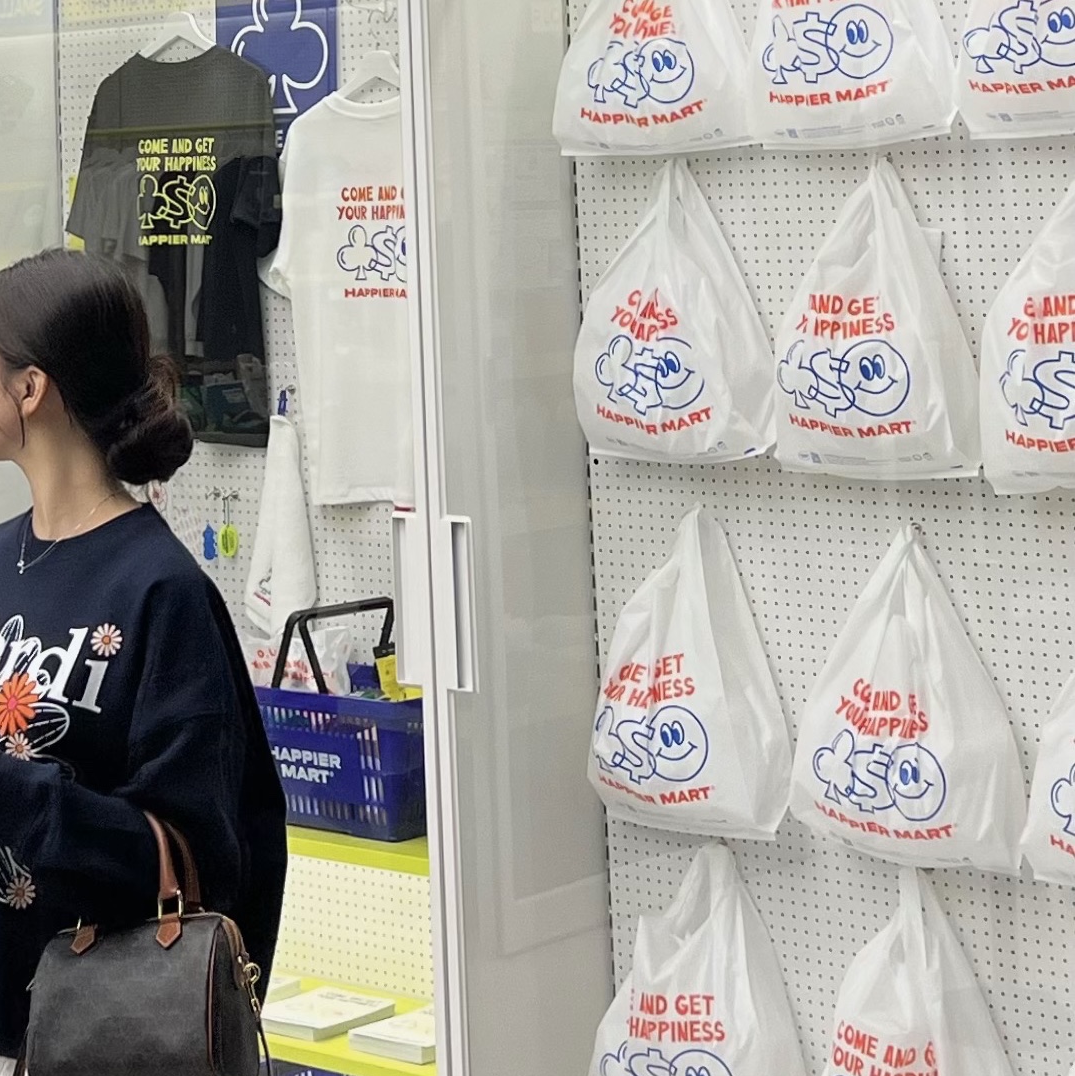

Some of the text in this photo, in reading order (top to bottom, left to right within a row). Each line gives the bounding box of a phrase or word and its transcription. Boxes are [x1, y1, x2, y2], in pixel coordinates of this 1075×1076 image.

[835, 80, 889, 102] MART
[652, 100, 704, 125] MART
[138, 137, 215, 154] COME AND GET
[136, 157, 161, 172] YOUR
[341, 186, 374, 202] COME
[378, 185, 397, 201] AND
[336, 206, 367, 220] YOUR
[661, 407, 713, 433] MART
[789, 413, 912, 438] HAPPIER MART
[872, 691, 901, 711] AND
[281, 764, 330, 784] MART
[660, 786, 711, 805] MART
[893, 825, 953, 840] MART
[675, 994, 714, 1016] GET
[628, 1016, 725, 1042] HAPPINESS
[837, 1020, 878, 1058] COME
[883, 1045, 916, 1069] AND
